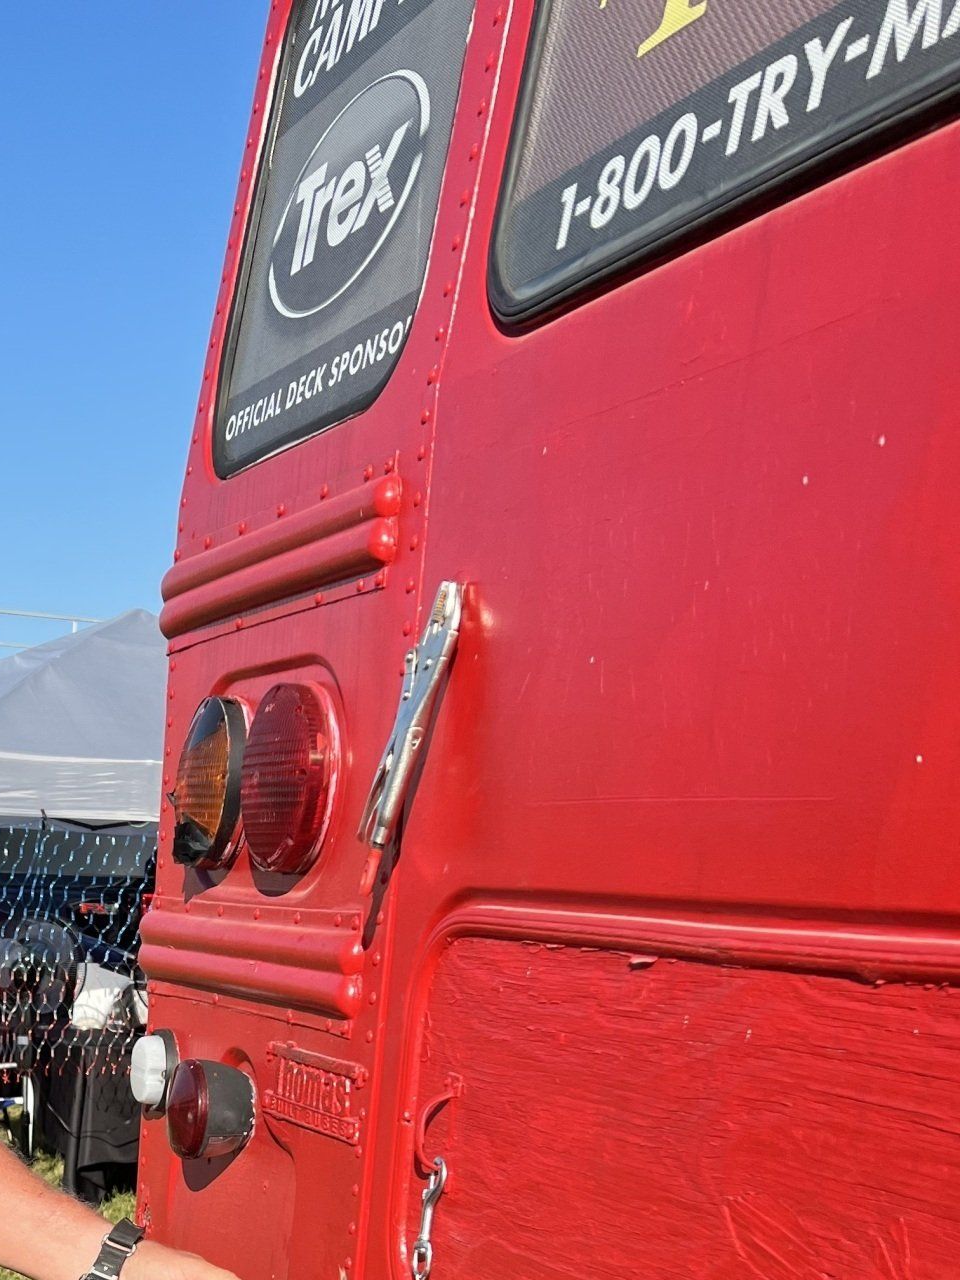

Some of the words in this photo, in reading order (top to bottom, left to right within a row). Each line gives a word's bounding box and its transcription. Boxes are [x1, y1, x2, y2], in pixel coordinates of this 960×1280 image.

[289, 119, 412, 277] Trex
[225, 388, 282, 441] OFFICIAL
[285, 363, 327, 410] DECK
[328, 315, 412, 388] SPONSO
[305, 1107, 347, 1133] BUSES
